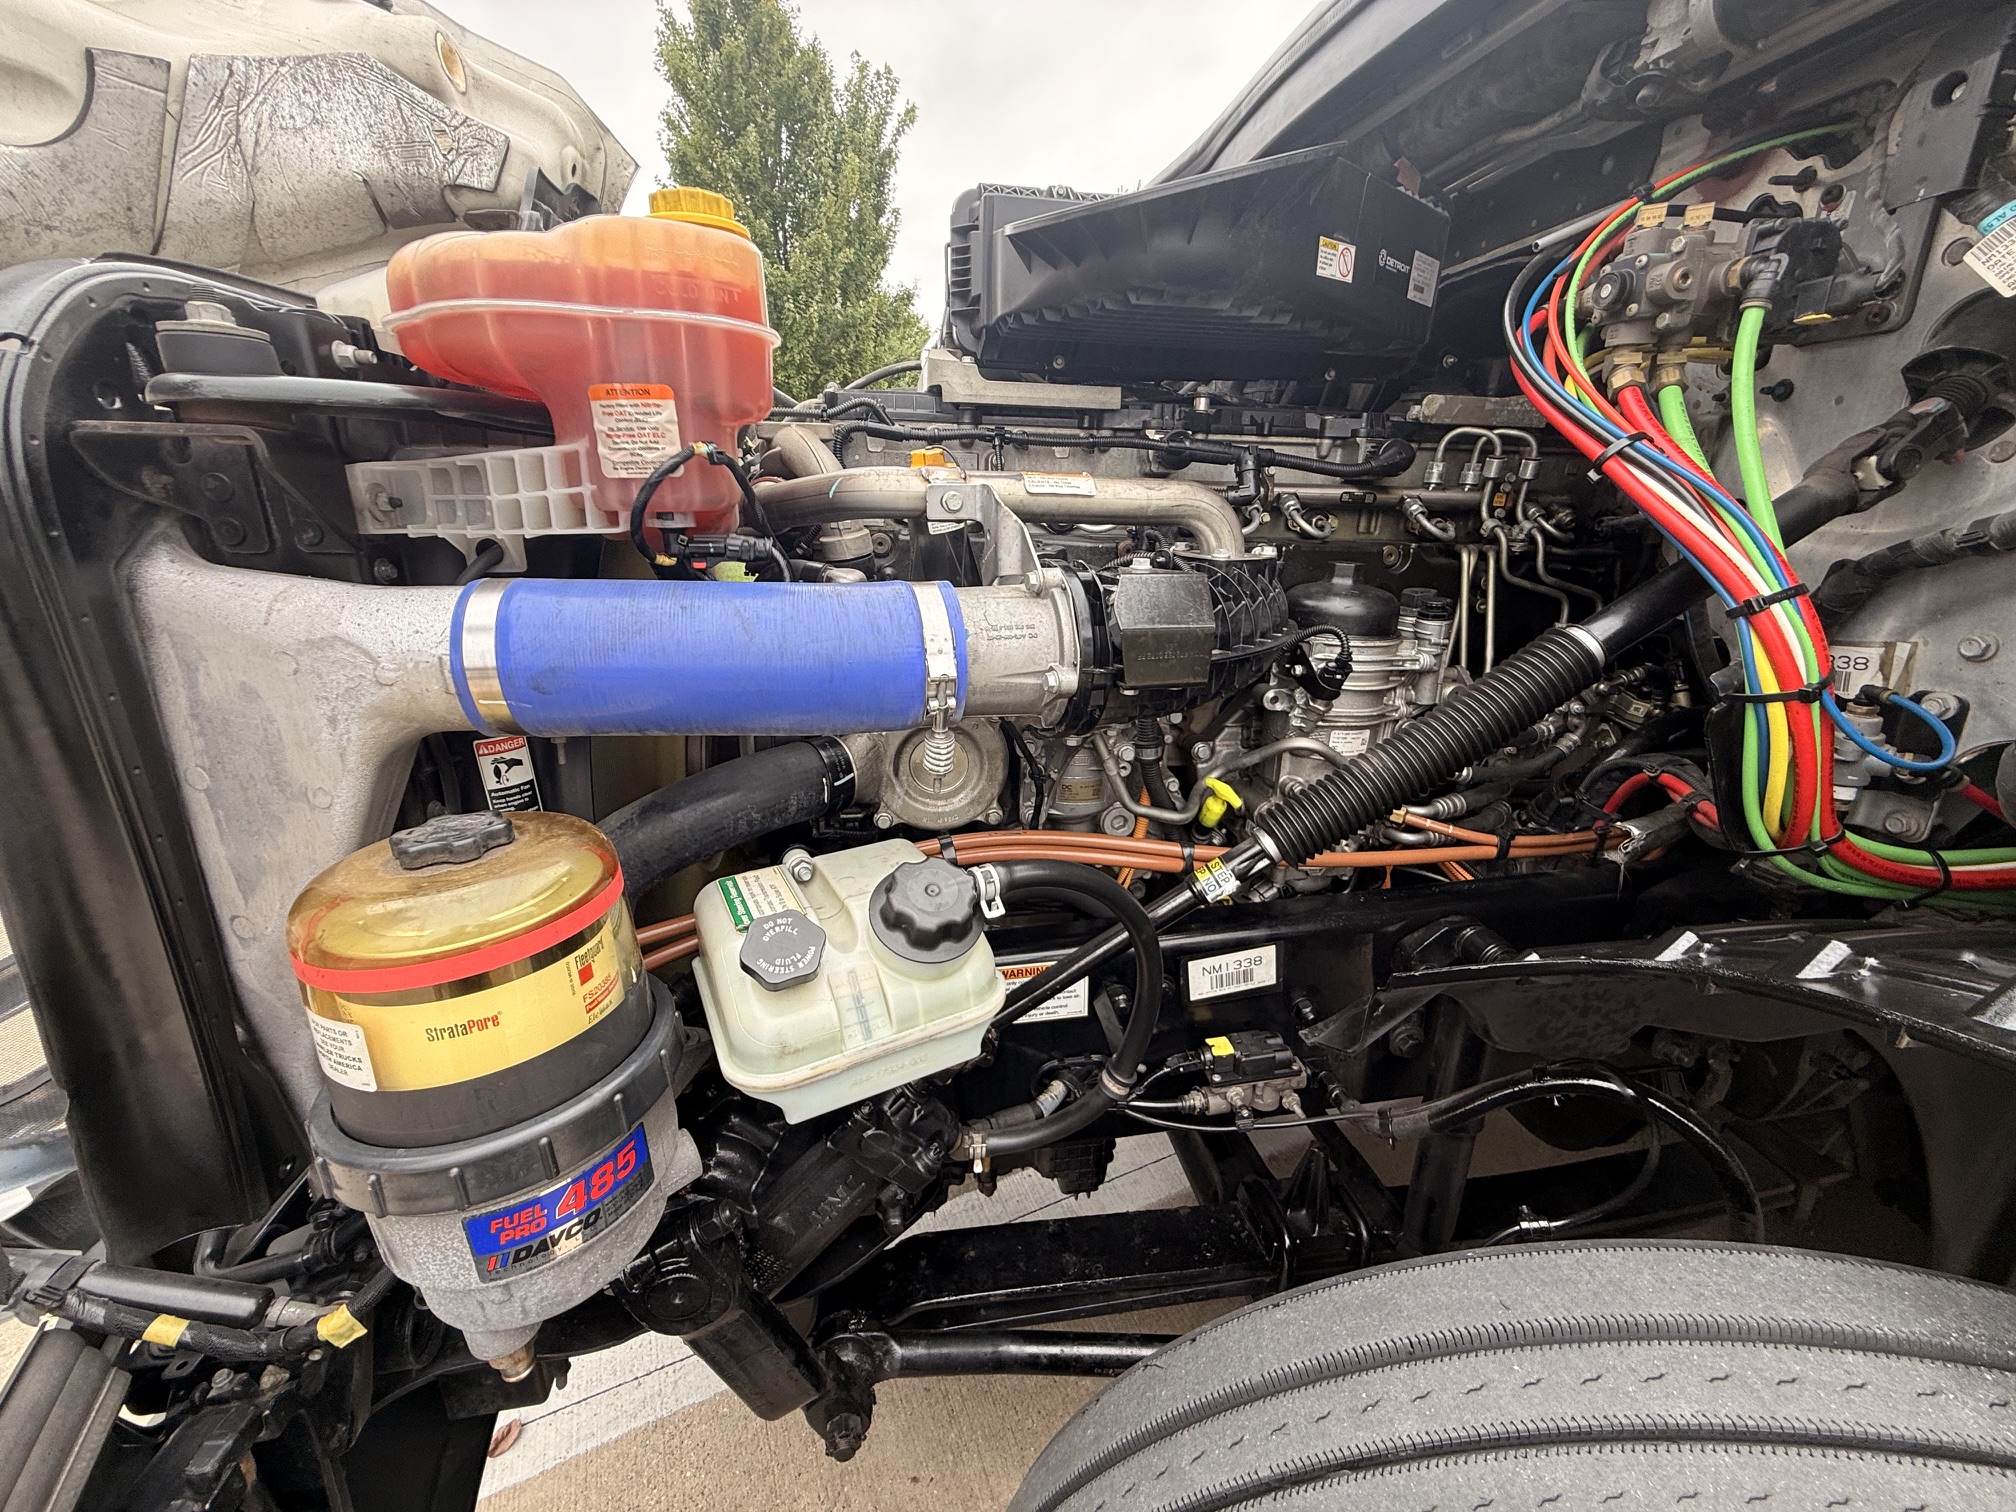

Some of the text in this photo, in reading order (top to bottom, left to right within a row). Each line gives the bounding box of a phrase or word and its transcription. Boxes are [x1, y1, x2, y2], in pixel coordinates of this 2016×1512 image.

[1981, 236, 2016, 266] NM133
[1386, 256, 1411, 274] DETROIT
[605, 388, 651, 397] ATTENTION
[488, 737, 525, 753] DANGER
[1210, 861, 1231, 887] STEP
[1202, 877, 1217, 893] NO
[741, 914, 751, 925] ower
[763, 917, 793, 930] DO NOT
[762, 925, 799, 942] OVERFILL
[756, 945, 816, 974] POWER STEERING
[775, 952, 802, 966] FLUID
[1202, 955, 1263, 977] NM1338
[1001, 965, 1048, 979] WARNIN
[337, 1030, 348, 1038] OR
[333, 1059, 363, 1072] AMERICA
[335, 1052, 363, 1064] TRUCKS
[555, 1139, 637, 1220] 485
[490, 1203, 548, 1234] FUEL
[500, 1216, 547, 1245] PRO
